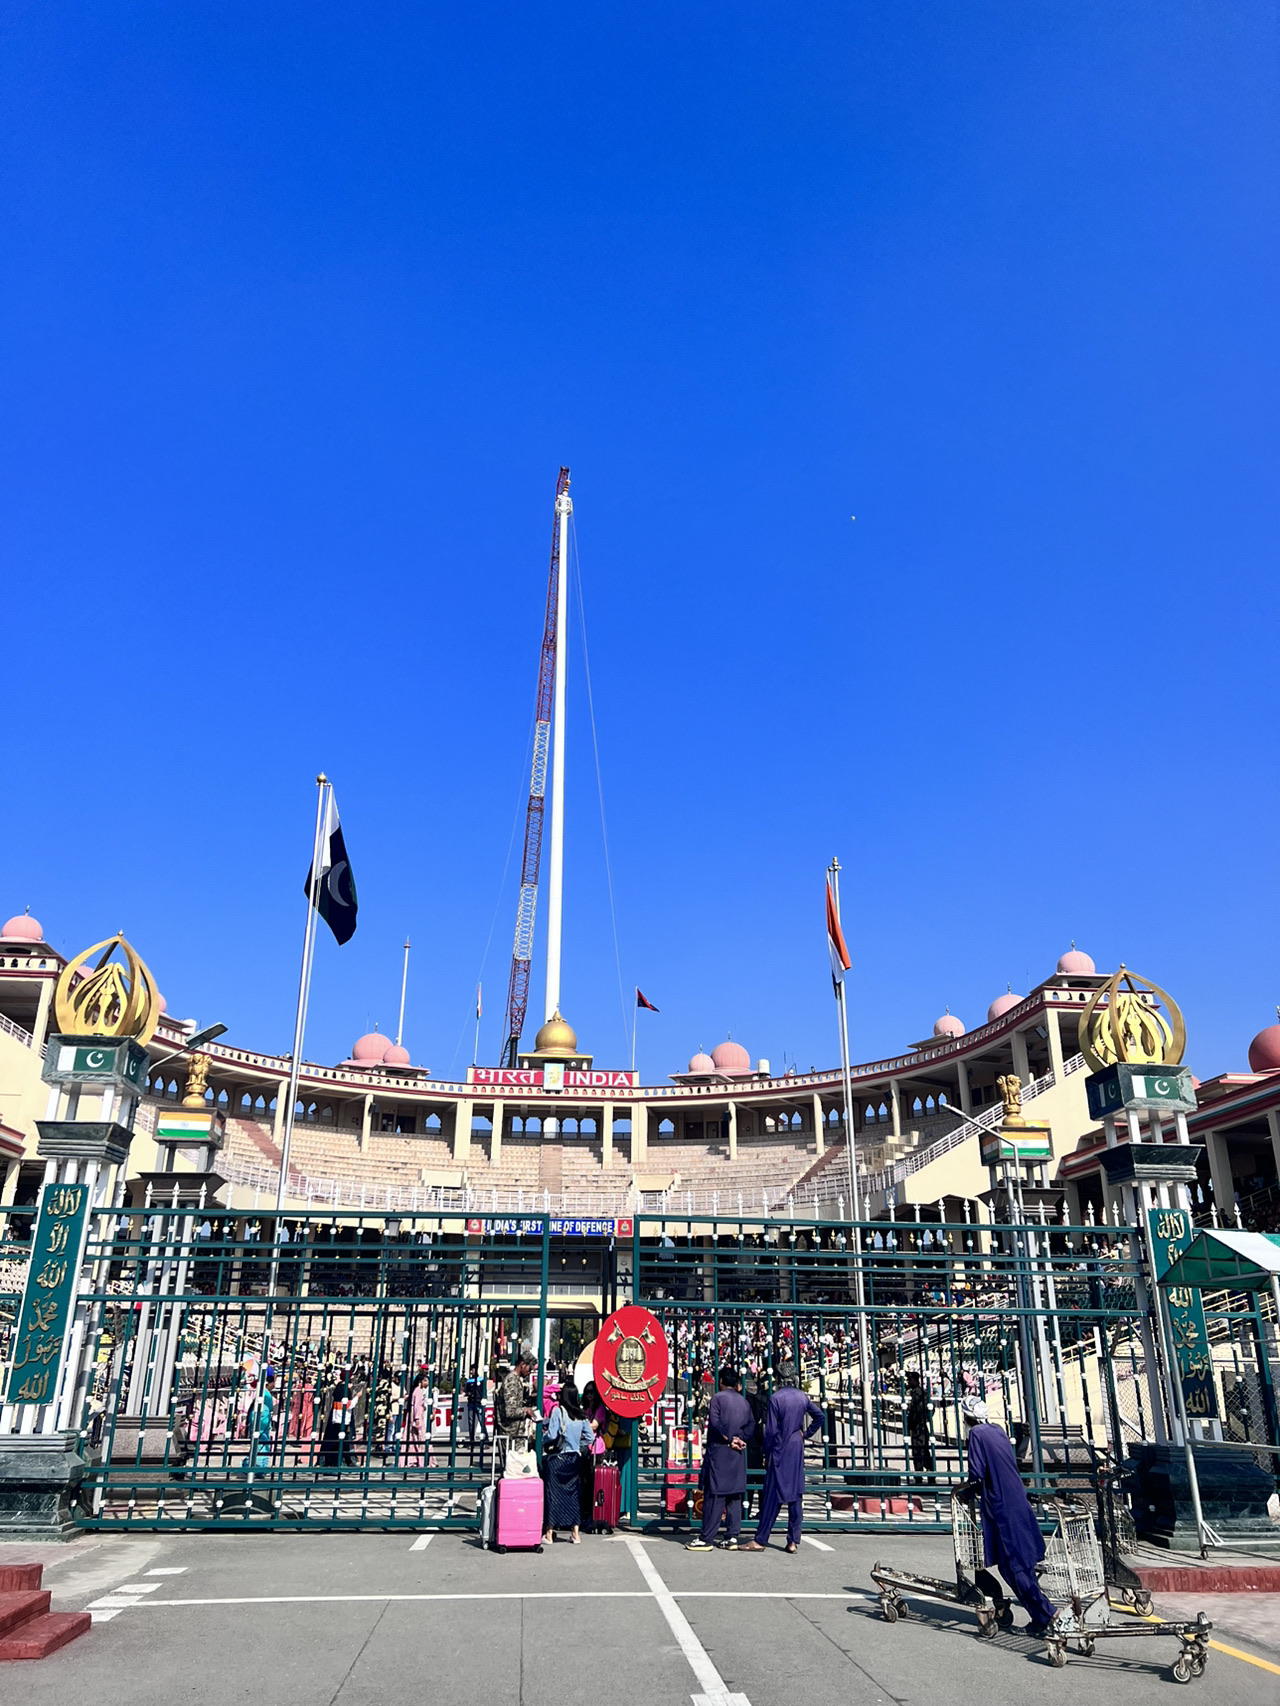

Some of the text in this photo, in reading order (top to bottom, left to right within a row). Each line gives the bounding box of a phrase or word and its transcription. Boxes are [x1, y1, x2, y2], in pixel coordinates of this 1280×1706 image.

[477, 1069, 537, 1084] भारत
[569, 1071, 630, 1086] INDIA
[563, 1221, 574, 1232] OF
[575, 1221, 613, 1232] DEFENCE
